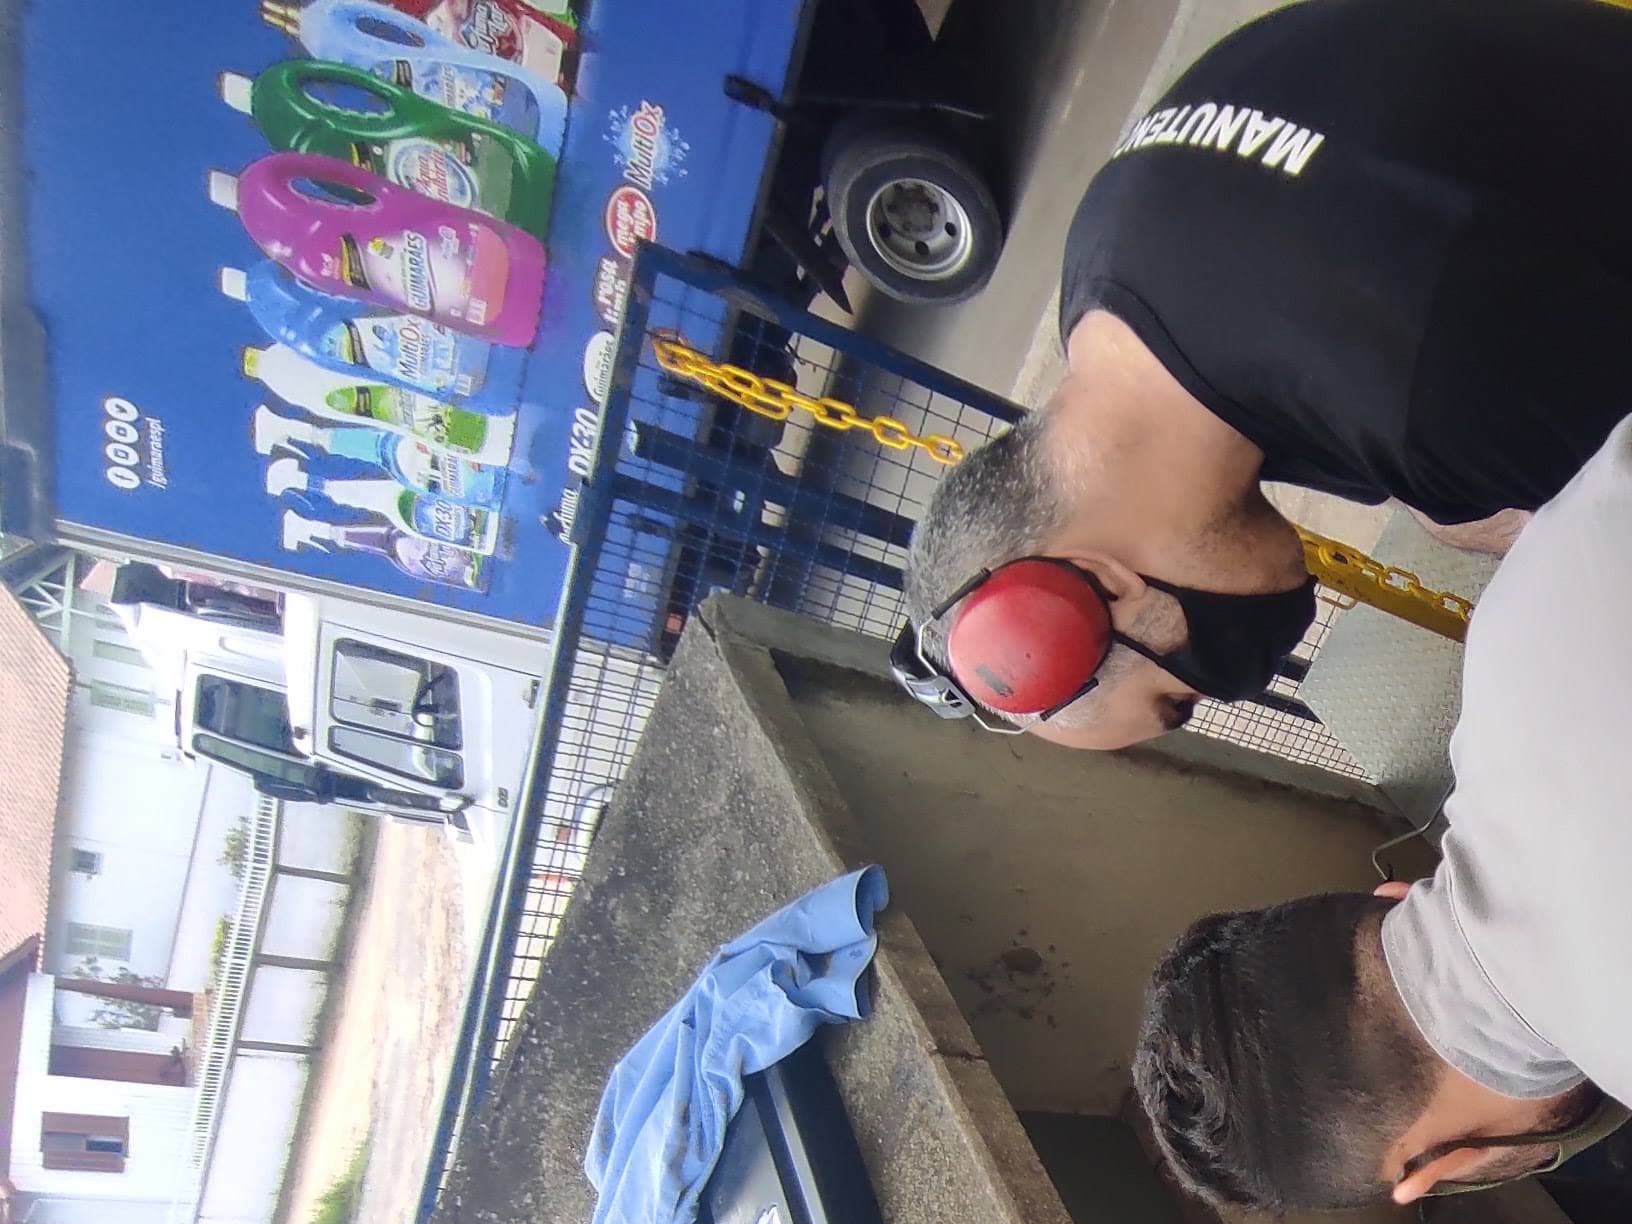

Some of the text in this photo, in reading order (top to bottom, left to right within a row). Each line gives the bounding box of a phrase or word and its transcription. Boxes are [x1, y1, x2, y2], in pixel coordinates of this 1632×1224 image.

[625, 101, 664, 189] MultiOx
[1113, 101, 1326, 177] MANUTEN
[615, 199, 633, 246] mega
[630, 200, 651, 244] mpo
[597, 257, 618, 305] rosa
[399, 320, 419, 379] MultiOx
